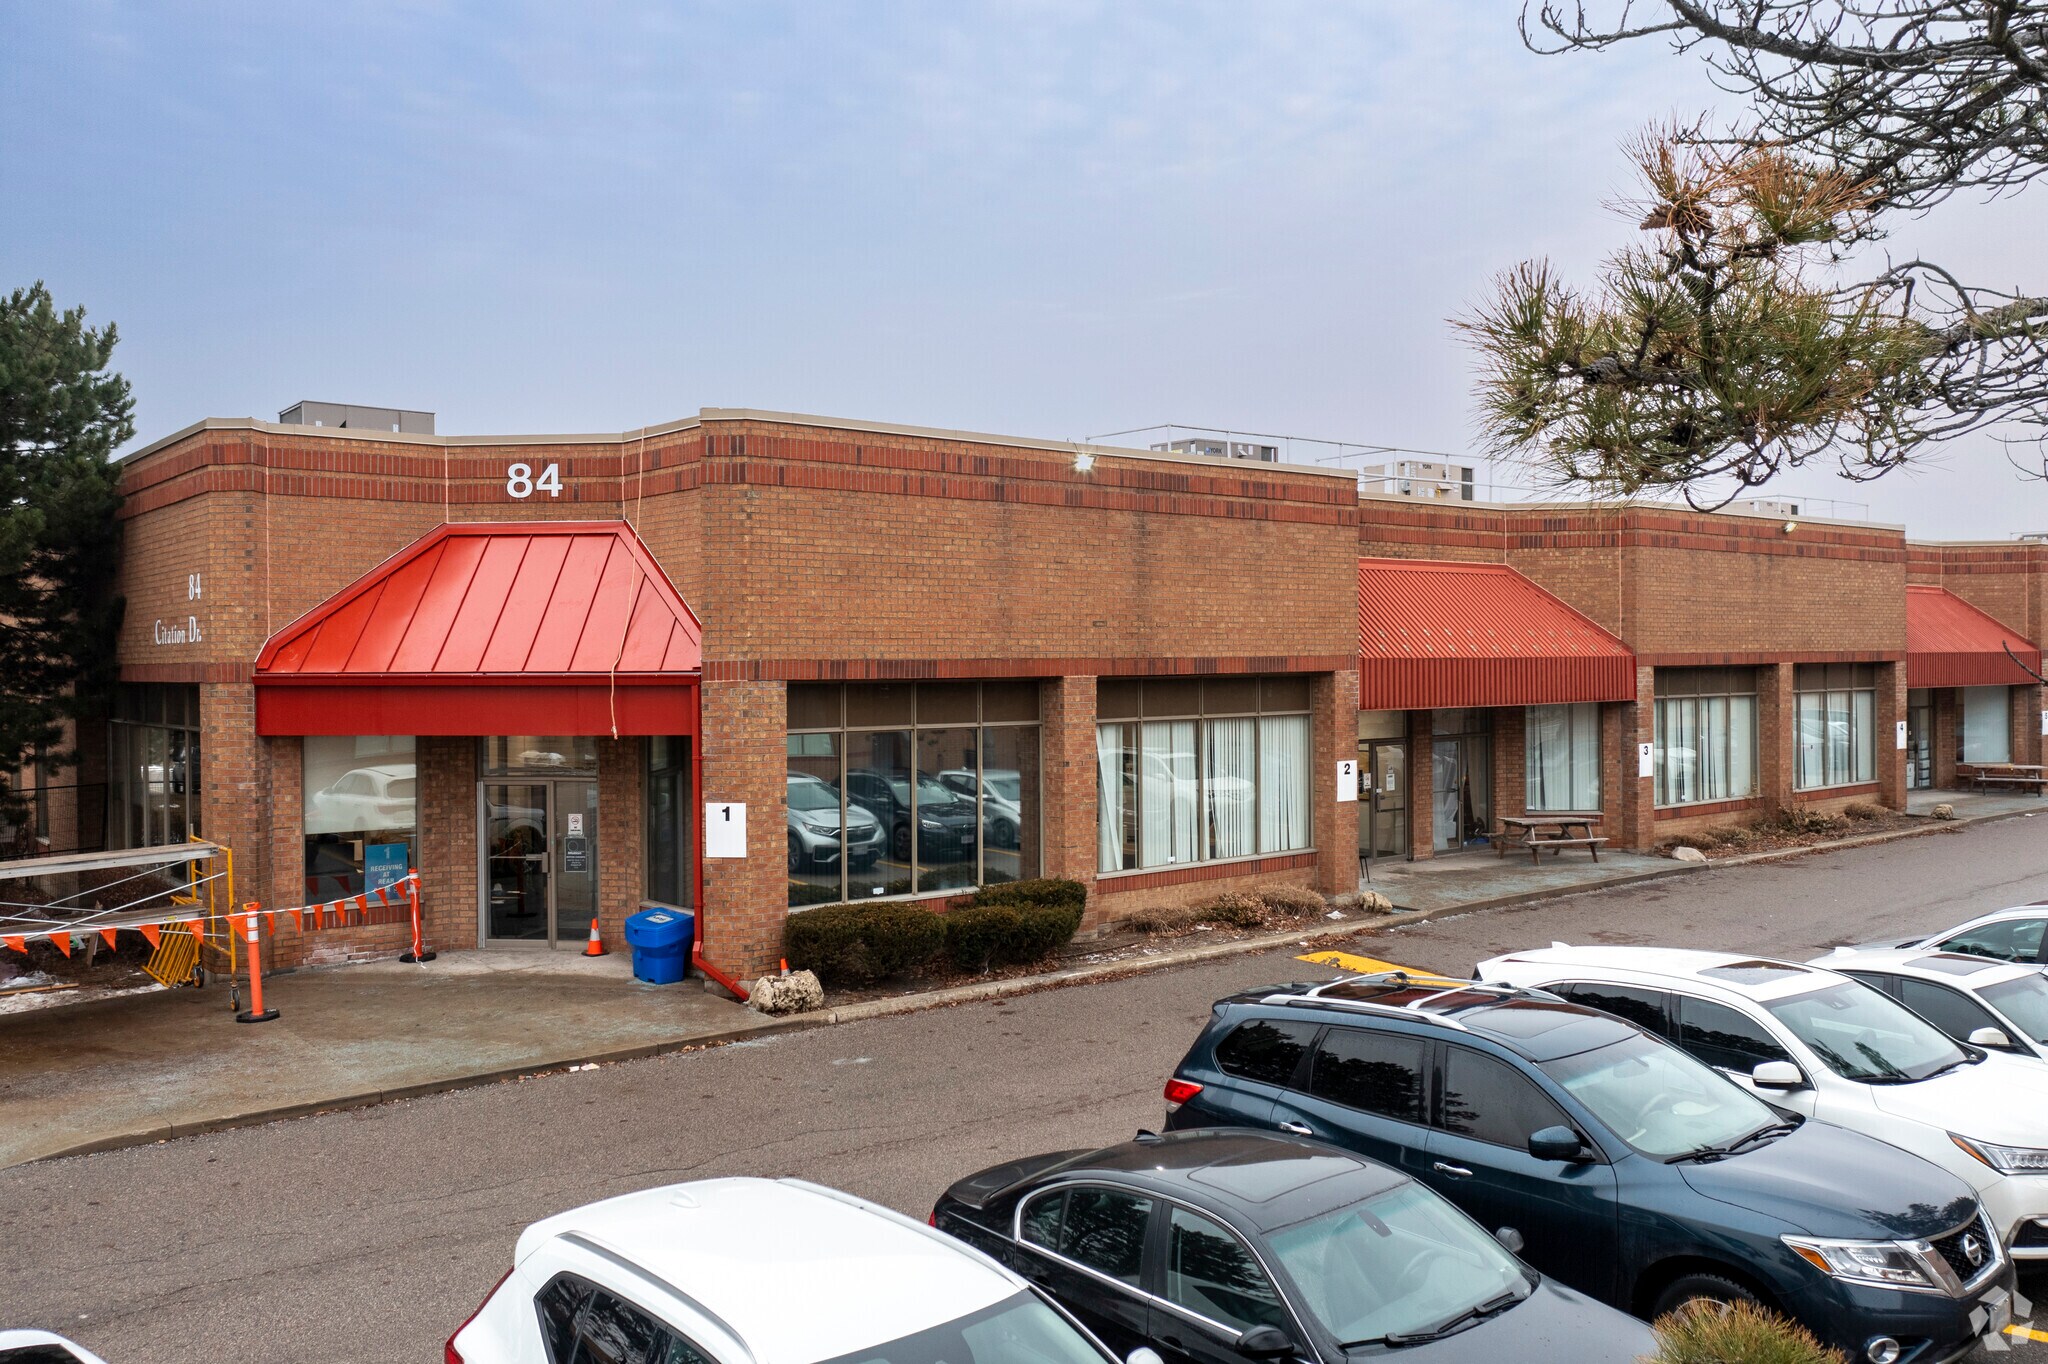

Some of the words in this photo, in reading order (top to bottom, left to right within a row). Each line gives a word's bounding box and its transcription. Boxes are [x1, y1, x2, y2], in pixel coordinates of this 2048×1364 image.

[507, 463, 563, 498] 84
[189, 573, 201, 600] 84
[155, 620, 186, 645] Citation
[189, 616, 202, 642] Dr.
[1643, 745, 1649, 755] 3
[1344, 763, 1351, 775] 2
[722, 806, 730, 821] 1
[384, 847, 390, 859] 1
[370, 864, 403, 872] RECEIVING
[377, 877, 395, 885] REAR
